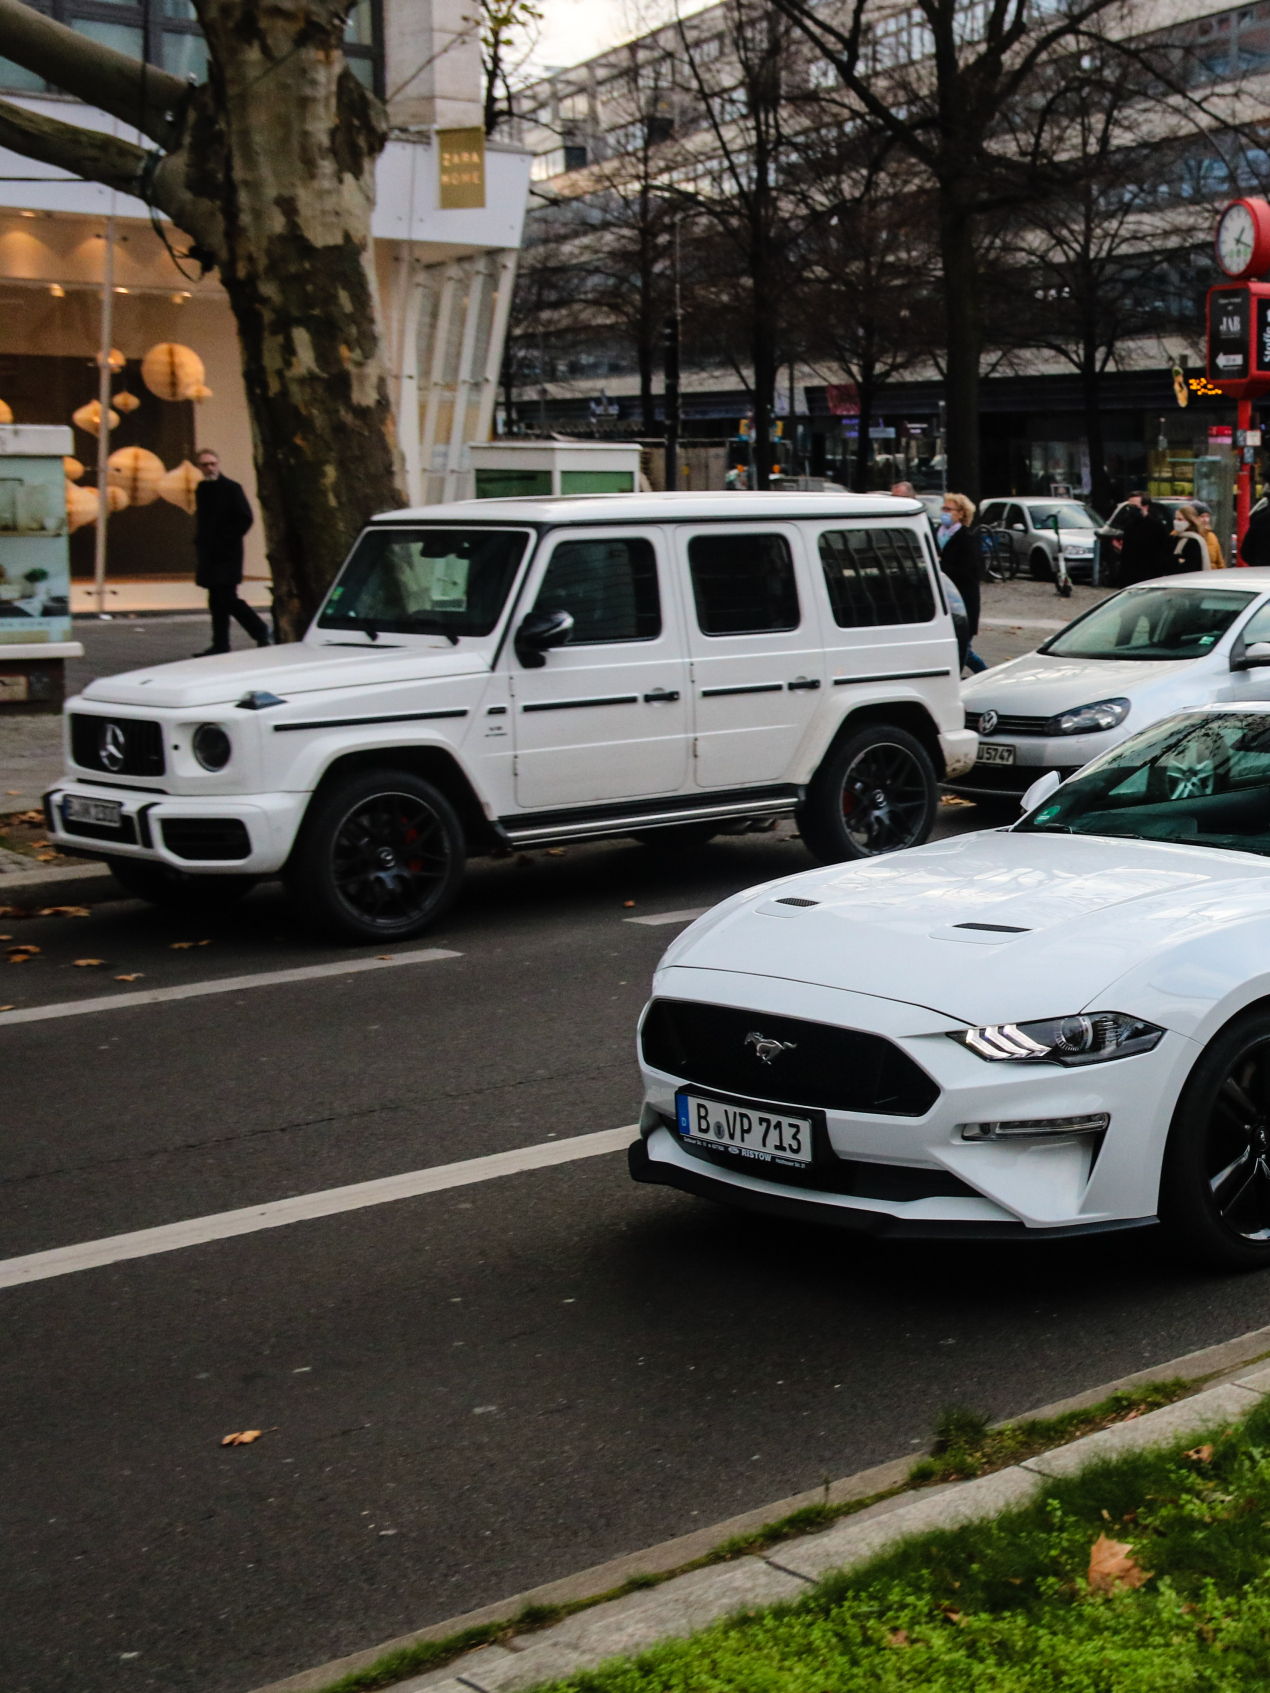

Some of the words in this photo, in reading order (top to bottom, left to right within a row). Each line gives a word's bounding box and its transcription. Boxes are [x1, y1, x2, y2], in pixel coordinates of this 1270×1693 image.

[442, 151, 480, 166] ZARA
[1219, 315, 1241, 332] JAB
[985, 747, 1012, 762] 5747
[696, 1103, 711, 1134] B
[724, 1109, 752, 1143] VP
[758, 1117, 802, 1154] 713
[741, 1149, 772, 1162] RISTOW
